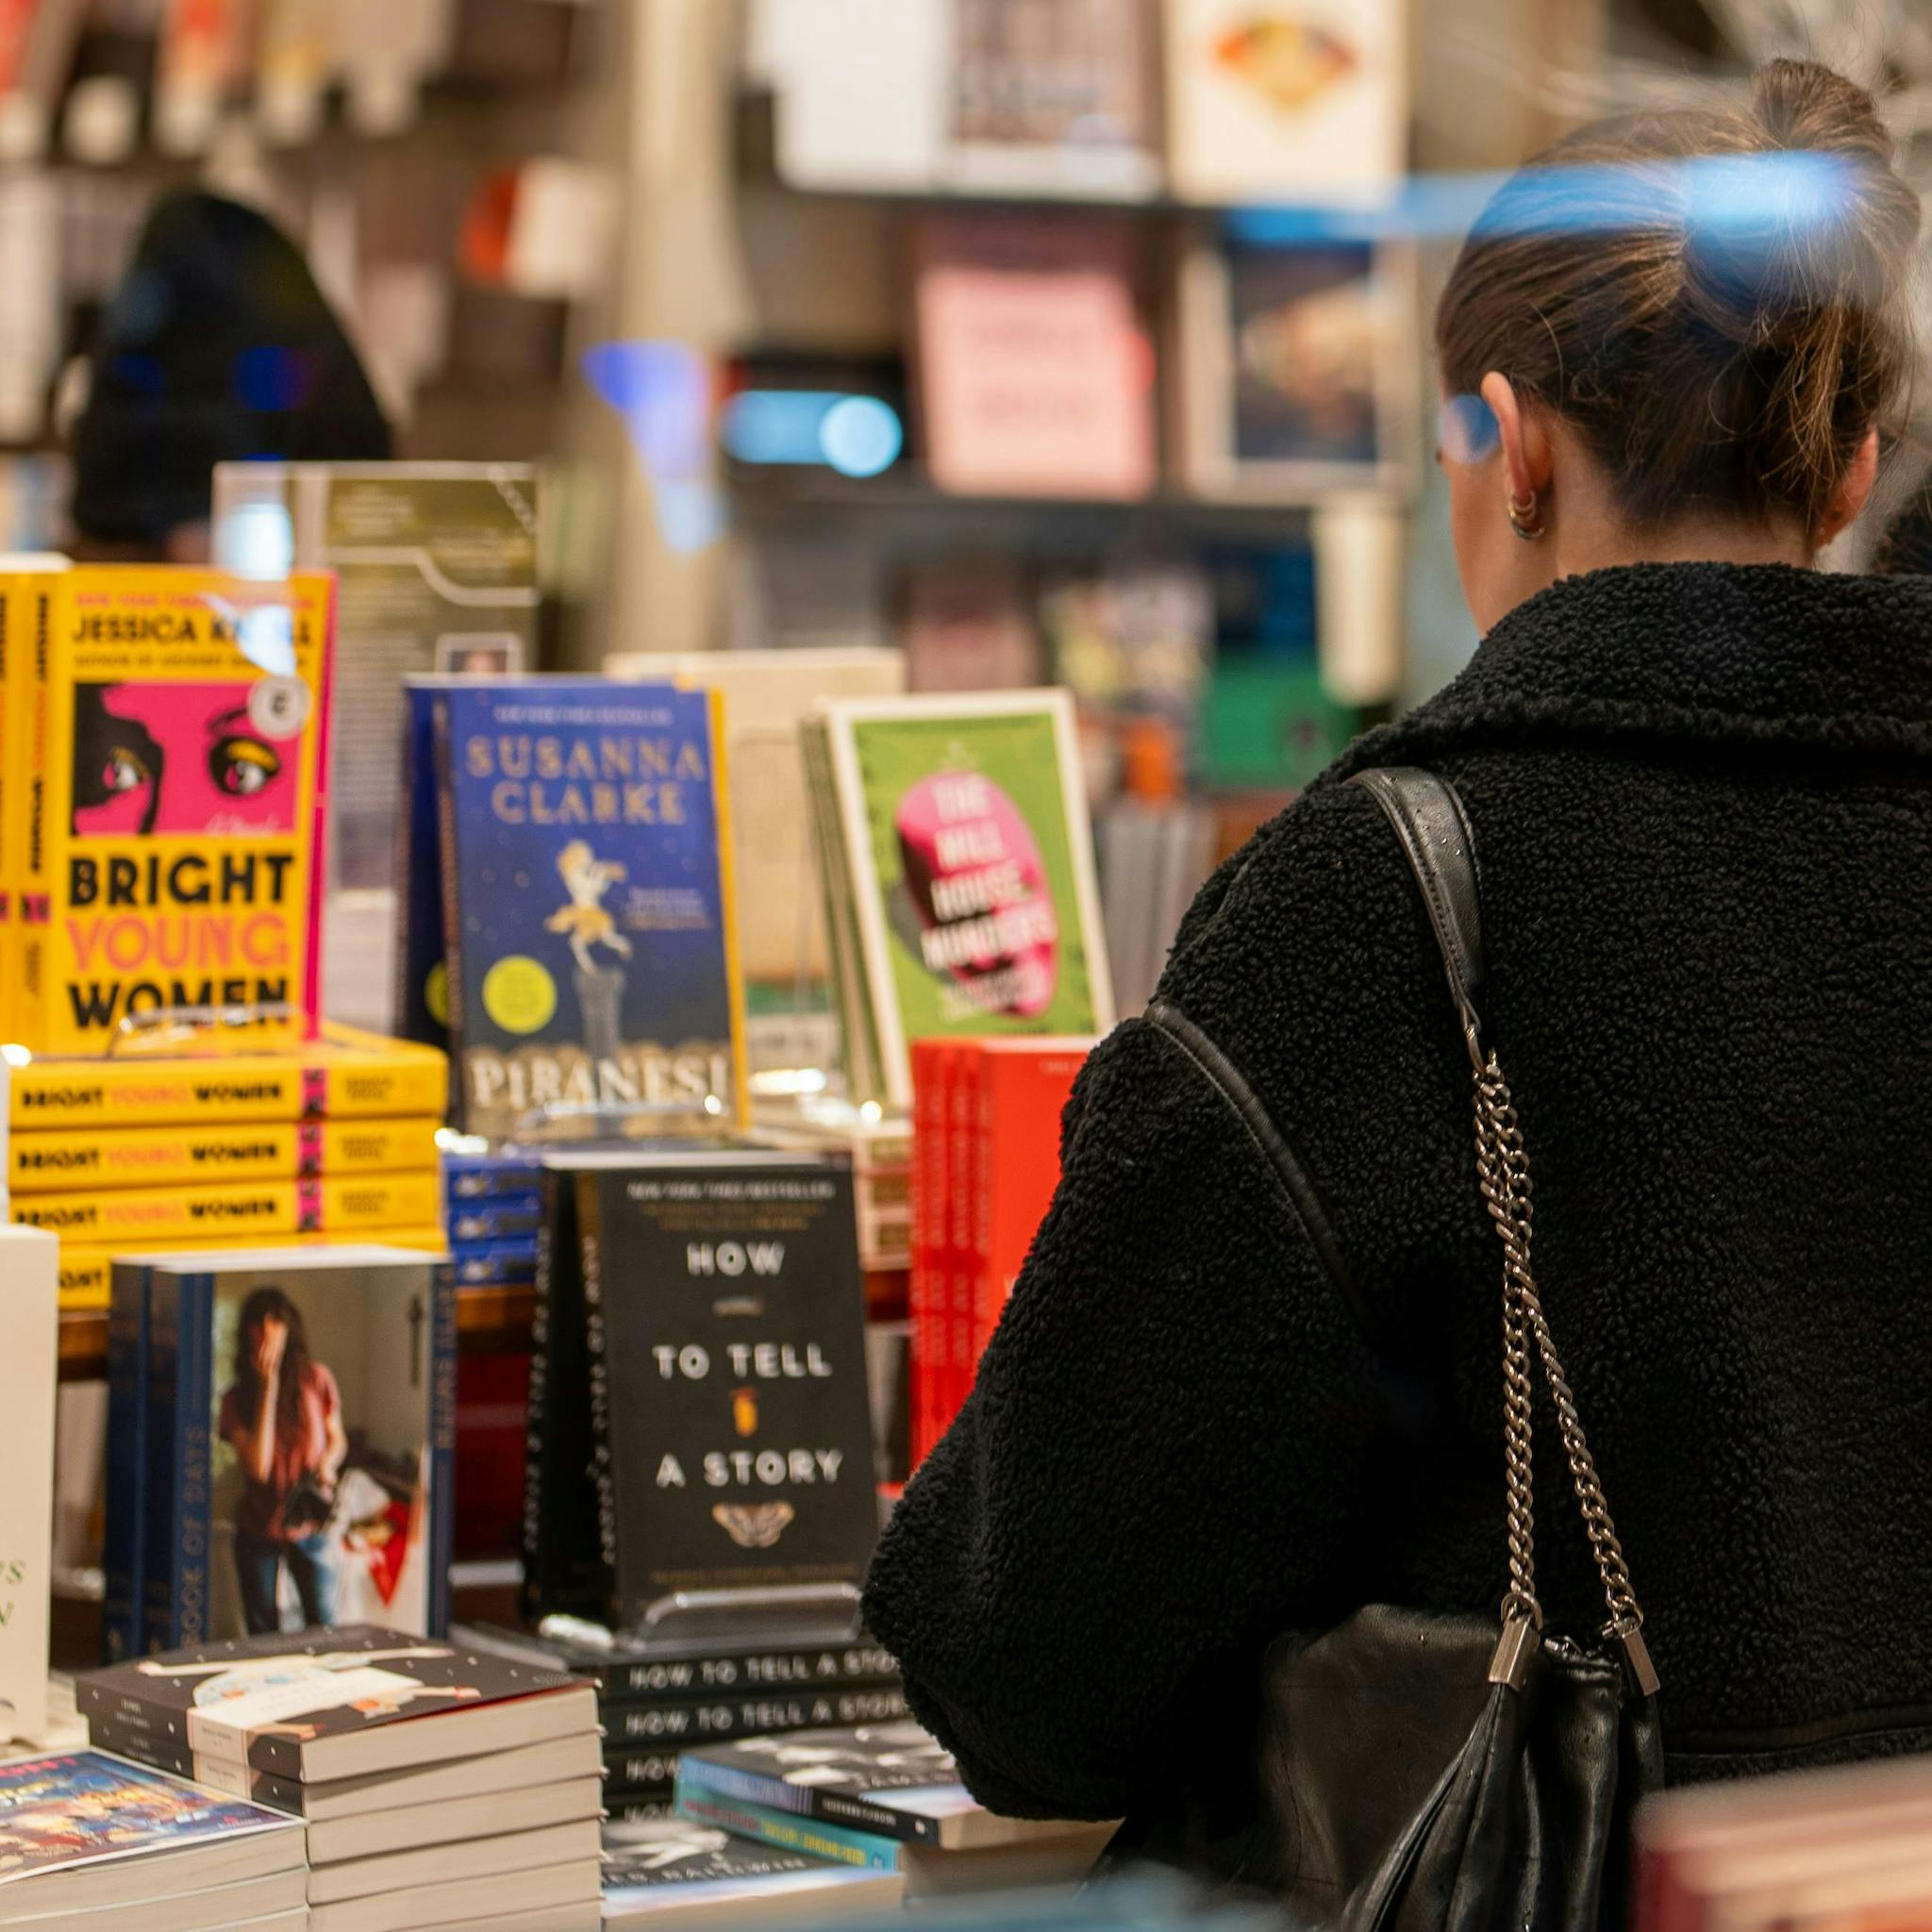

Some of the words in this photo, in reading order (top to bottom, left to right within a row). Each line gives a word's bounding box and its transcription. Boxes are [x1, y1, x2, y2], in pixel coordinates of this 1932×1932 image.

[73, 613, 196, 643] JESSICA
[465, 734, 707, 781] SUSANNA
[491, 780, 687, 825] CLARKE
[68, 854, 294, 908] BRIGHT
[66, 915, 290, 974] YOUNG
[67, 977, 290, 1029] WOMEN
[21, 1085, 104, 1110] BRIGHT
[192, 1080, 283, 1104] WOMEN
[471, 1054, 729, 1108] PIRANESI
[17, 1145, 100, 1171] BRIGHT
[188, 1141, 278, 1163] WOMEN
[15, 1204, 98, 1228] BRIGHT
[188, 1197, 277, 1221] WOMEN
[687, 1241, 785, 1276] HOW
[651, 1343, 710, 1379] TO
[725, 1341, 833, 1378] TELL
[655, 1453, 687, 1489] A
[703, 1448, 844, 1488] STORY
[629, 1663, 693, 1690] HOW
[701, 1657, 738, 1686] TO
[744, 1653, 810, 1682] TELL
[816, 1650, 839, 1677] A
[843, 1647, 902, 1675] STO
[625, 1709, 690, 1737] HOW
[696, 1705, 734, 1732] TO
[741, 1700, 806, 1728] TELL
[811, 1697, 834, 1724] A
[838, 1690, 908, 1722] STOR
[624, 1803, 675, 1828] HO
